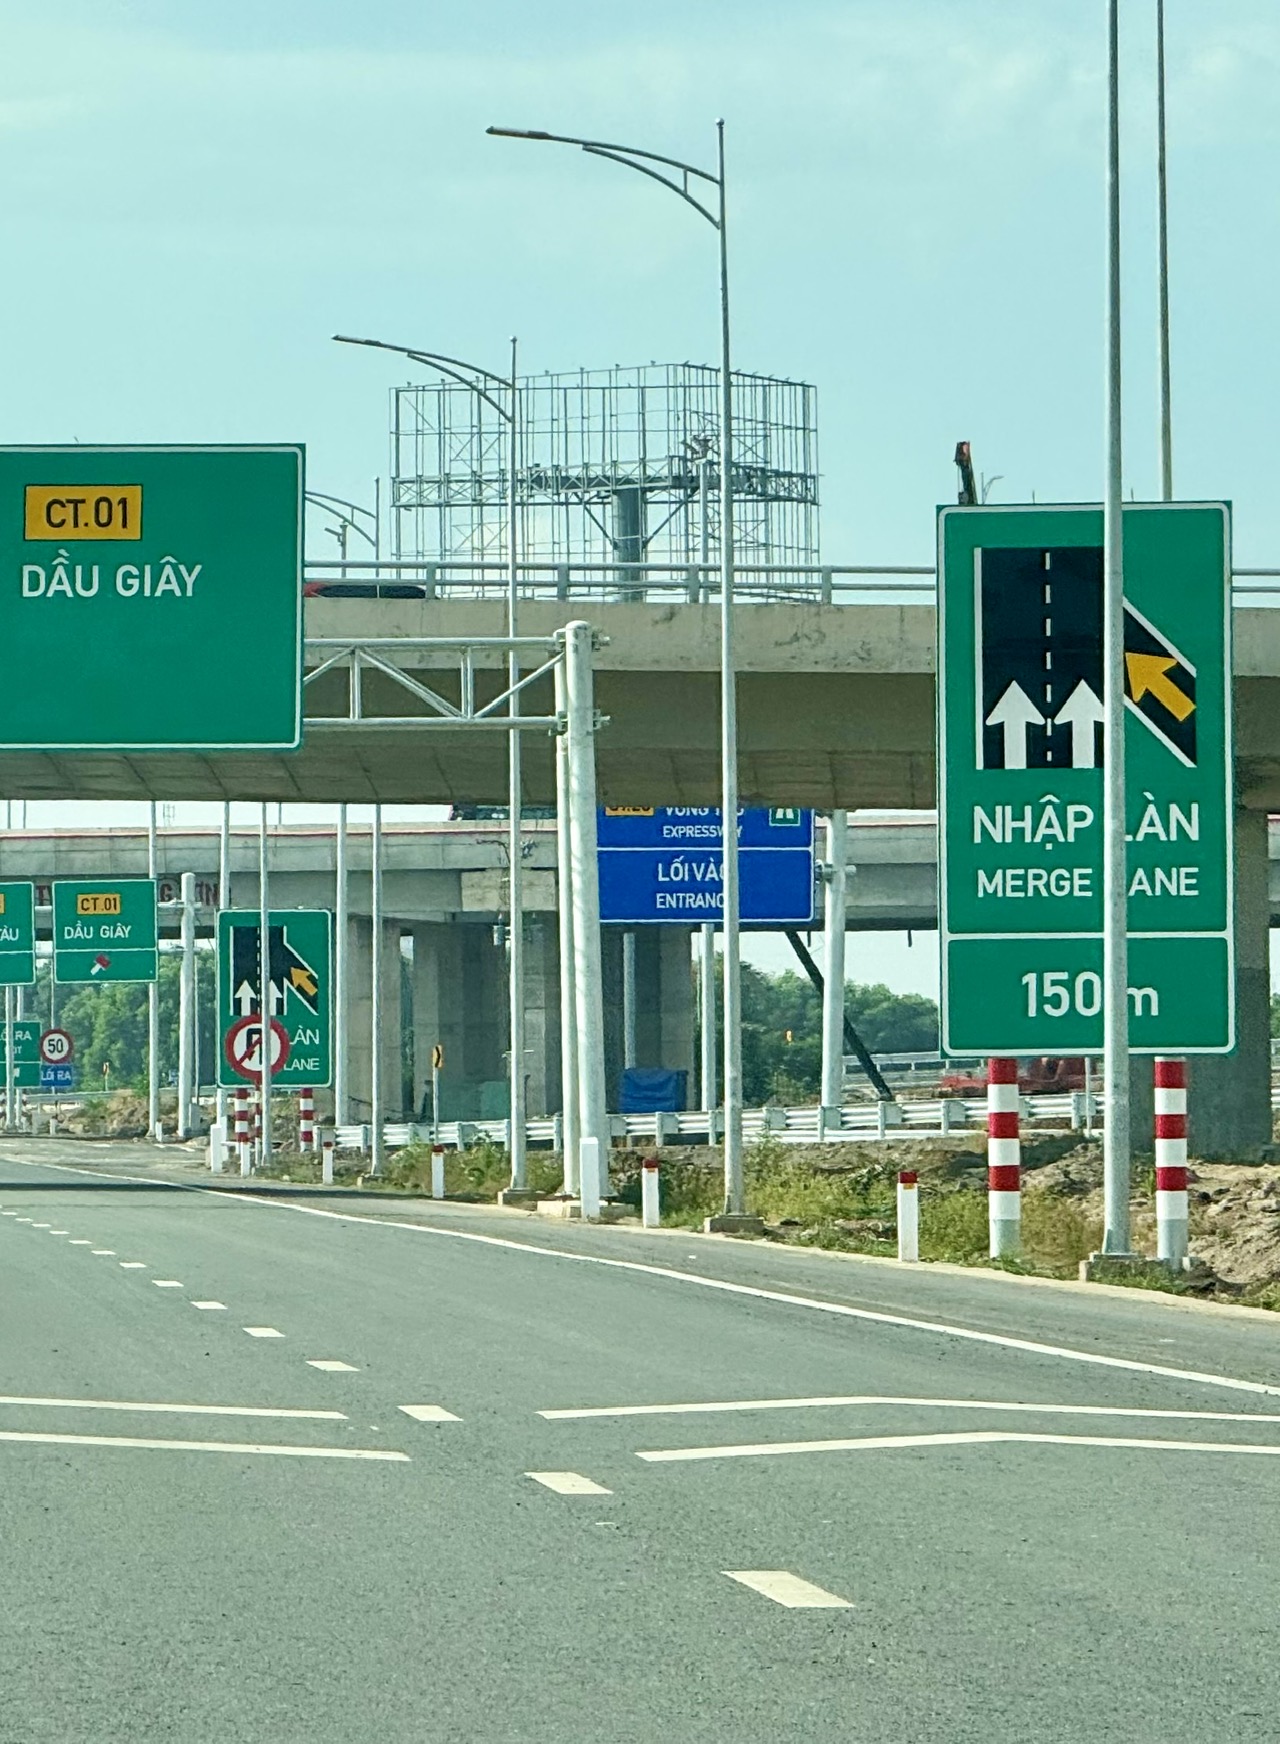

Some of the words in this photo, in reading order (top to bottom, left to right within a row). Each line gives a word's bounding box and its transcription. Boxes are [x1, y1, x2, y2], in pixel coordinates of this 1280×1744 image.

[45, 496, 128, 529] CT.01
[22, 548, 99, 597] DẦU
[115, 555, 202, 597] GIÂY
[973, 794, 1094, 849] NHẬP
[1125, 792, 1199, 841] ÀN
[662, 825, 743, 838] EXPRESSY
[658, 855, 689, 881] LỐI
[977, 868, 1093, 897] MERGE
[1128, 867, 1199, 896] ANE
[81, 896, 117, 911] CT.01
[656, 892, 724, 908] ENTRANC
[64, 920, 94, 940] DẦU
[100, 922, 132, 939] GIÂY
[1021, 971, 1102, 1018] 150
[15, 1030, 32, 1041] RA
[289, 1025, 320, 1045] ÀN
[48, 1038, 64, 1054] 50
[284, 1058, 320, 1071] LANE
